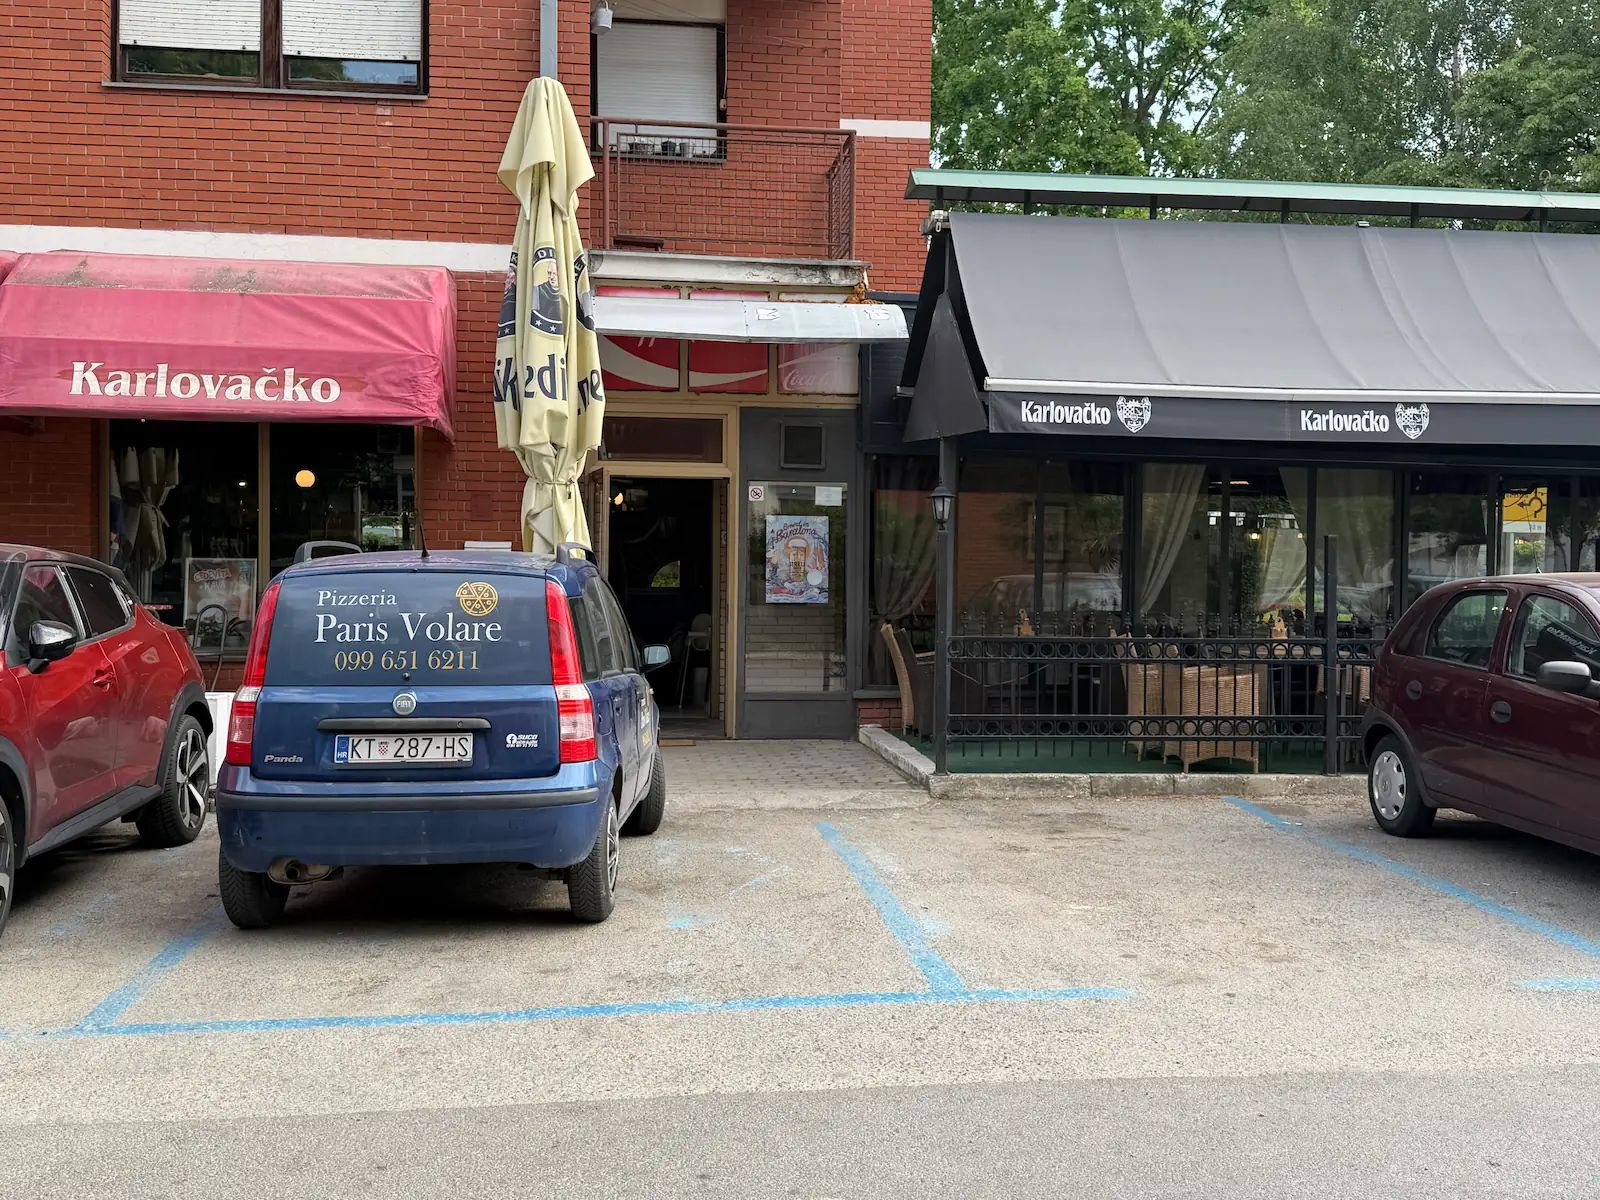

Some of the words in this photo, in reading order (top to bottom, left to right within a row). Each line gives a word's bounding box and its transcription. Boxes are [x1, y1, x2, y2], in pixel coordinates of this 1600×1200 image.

[68, 361, 341, 403] Karlovačko
[1021, 400, 1111, 424] Karlovačko
[1300, 409, 1390, 432] Karlovačko
[316, 589, 397, 606] Pizzeria
[313, 612, 388, 642] Paris
[399, 612, 502, 642] Volare
[335, 650, 374, 670] 099
[381, 650, 418, 670] 651
[428, 650, 479, 670] 6211
[396, 700, 412, 708] FIAT
[264, 754, 304, 763] Panda
[337, 751, 348, 759] HR
[350, 738, 376, 759] KT
[393, 737, 469, 758] 287-HS
